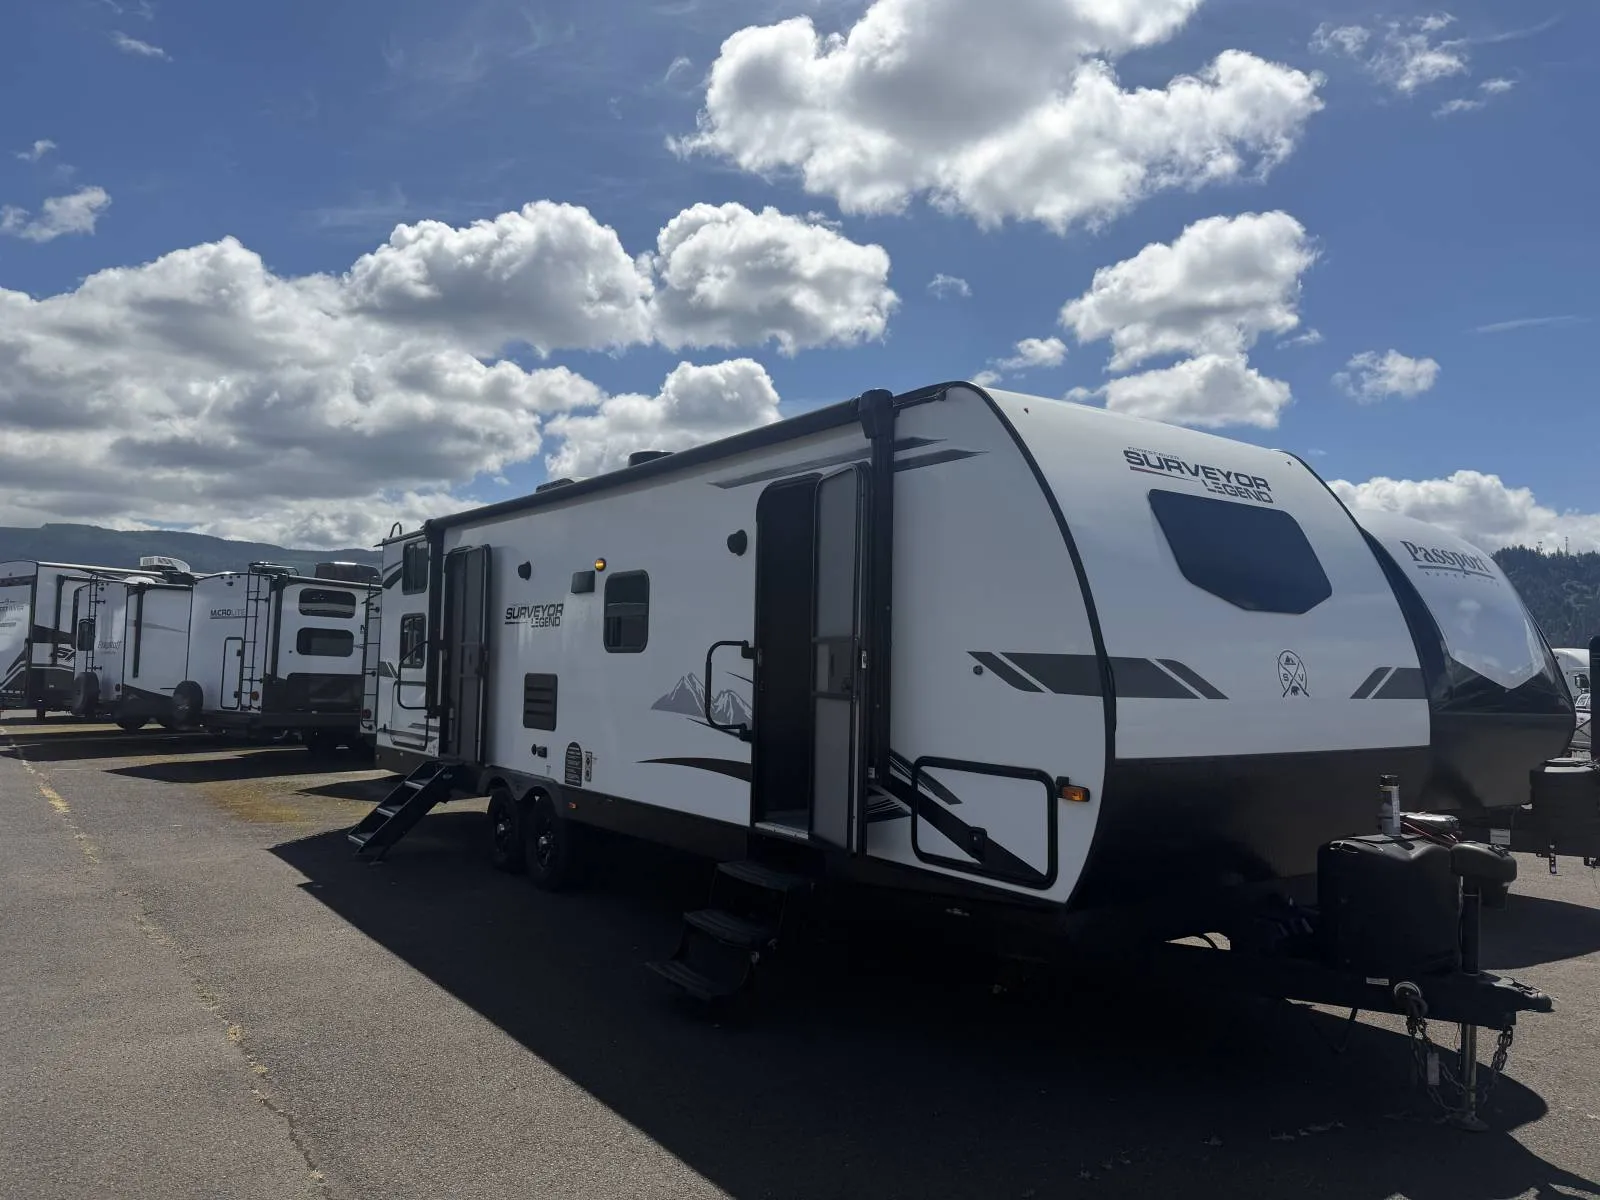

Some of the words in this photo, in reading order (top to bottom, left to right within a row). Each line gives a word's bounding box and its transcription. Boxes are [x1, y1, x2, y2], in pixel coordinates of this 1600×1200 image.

[1123, 449, 1272, 492] SURVEYOR
[1201, 479, 1274, 504] LEGEND
[1400, 540, 1491, 576] Passport
[505, 603, 564, 620] SURVEYOR
[530, 616, 561, 628] LEGEND
